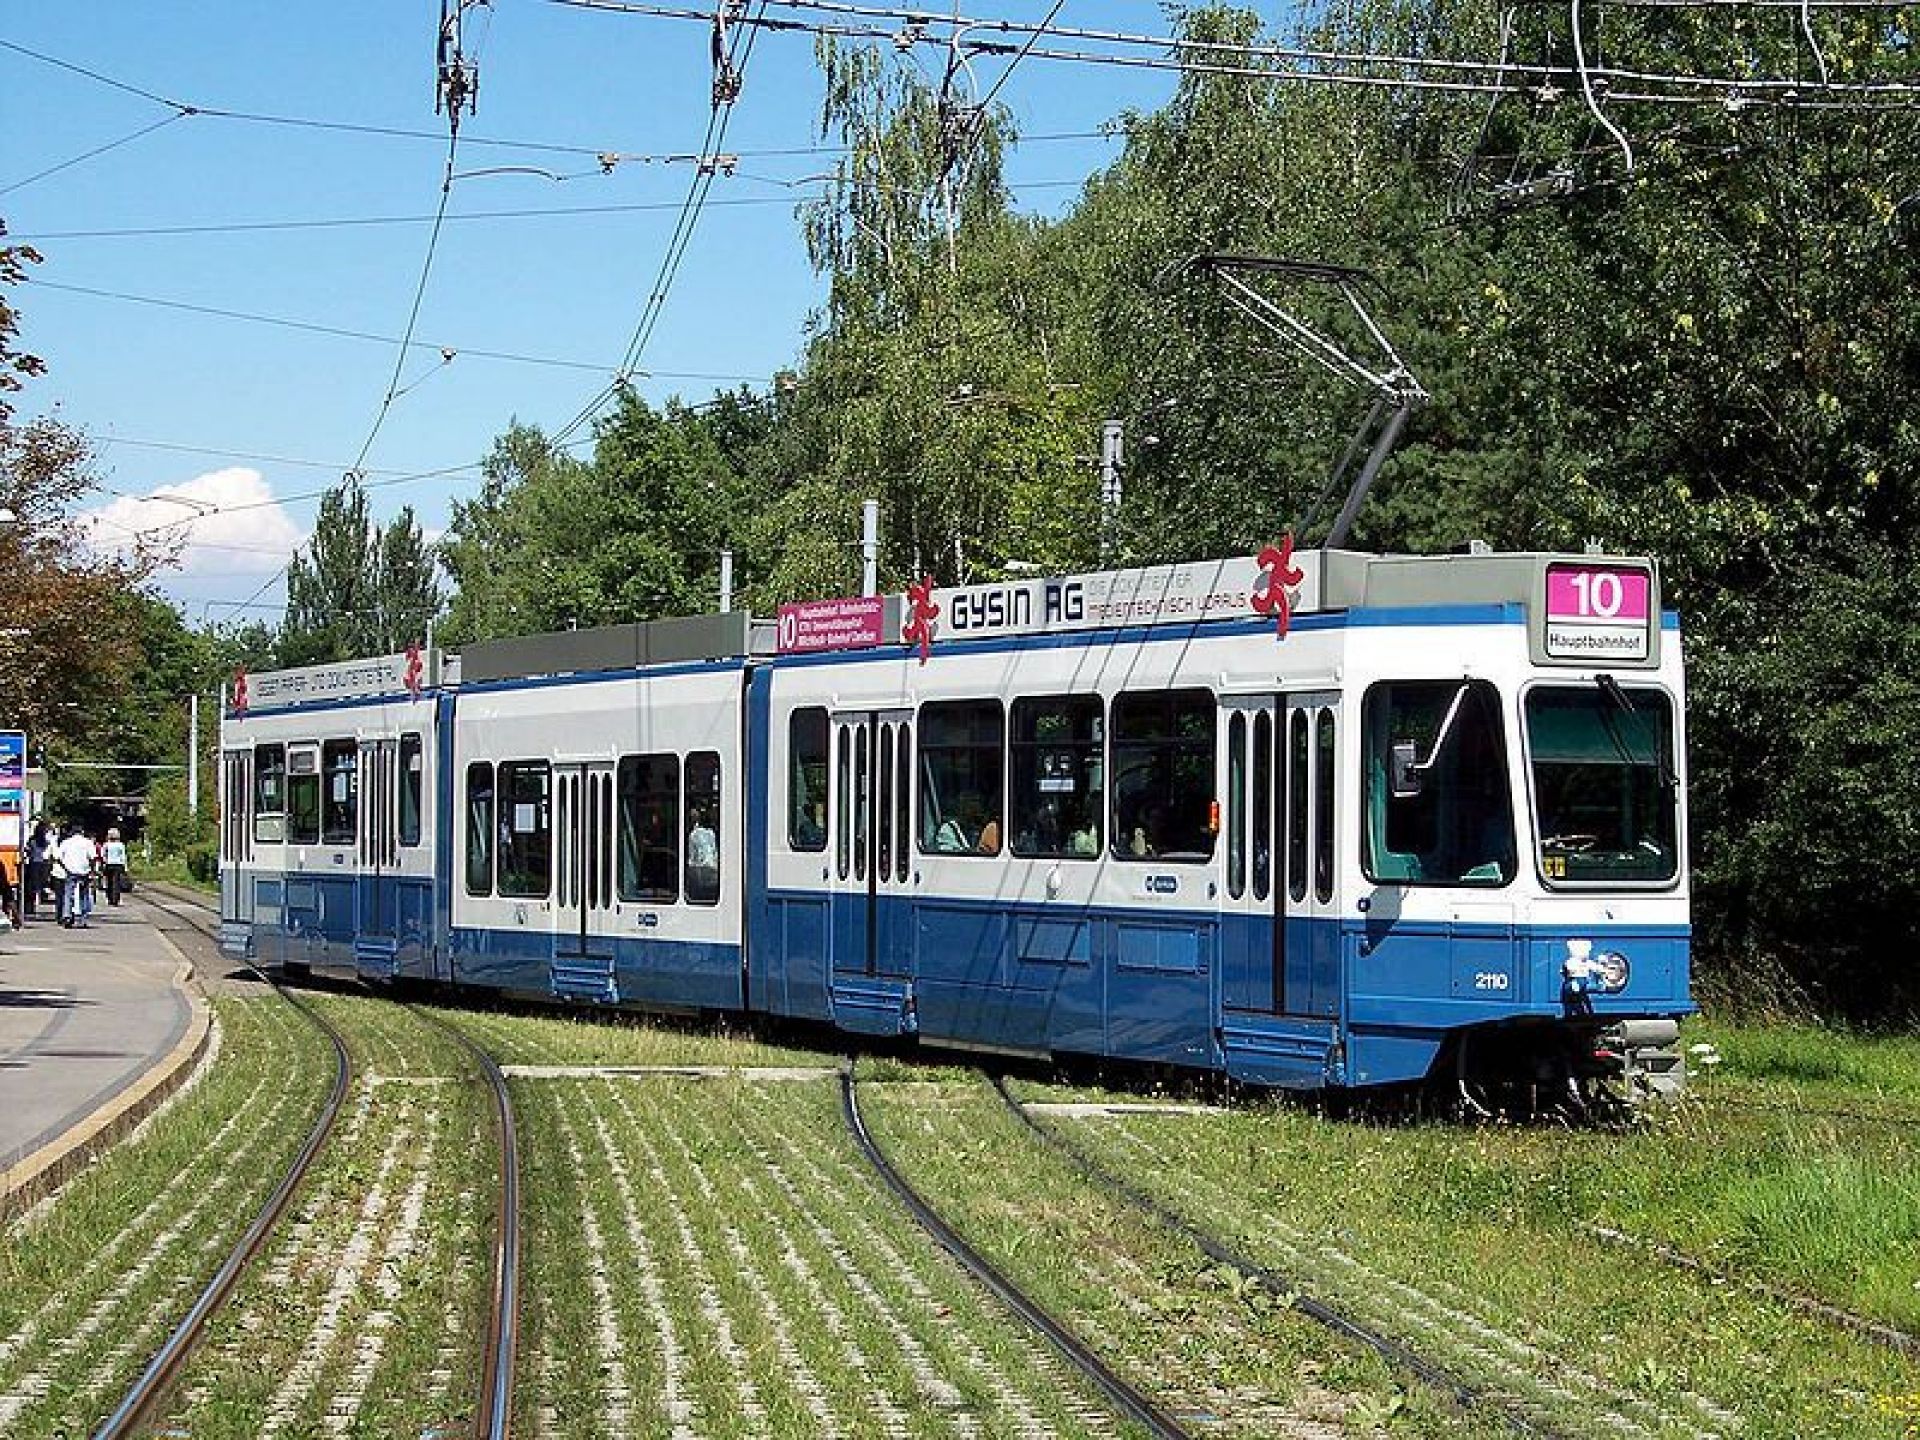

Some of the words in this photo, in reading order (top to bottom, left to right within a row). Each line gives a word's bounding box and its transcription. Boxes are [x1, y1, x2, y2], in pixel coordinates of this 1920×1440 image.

[951, 587, 1031, 630] GYSIN
[1045, 582, 1083, 624] AG
[1569, 572, 1623, 618] 10
[778, 612, 797, 649] 10
[1549, 632, 1640, 649] Hauptbahnhof
[1475, 971, 1508, 990] 2110
